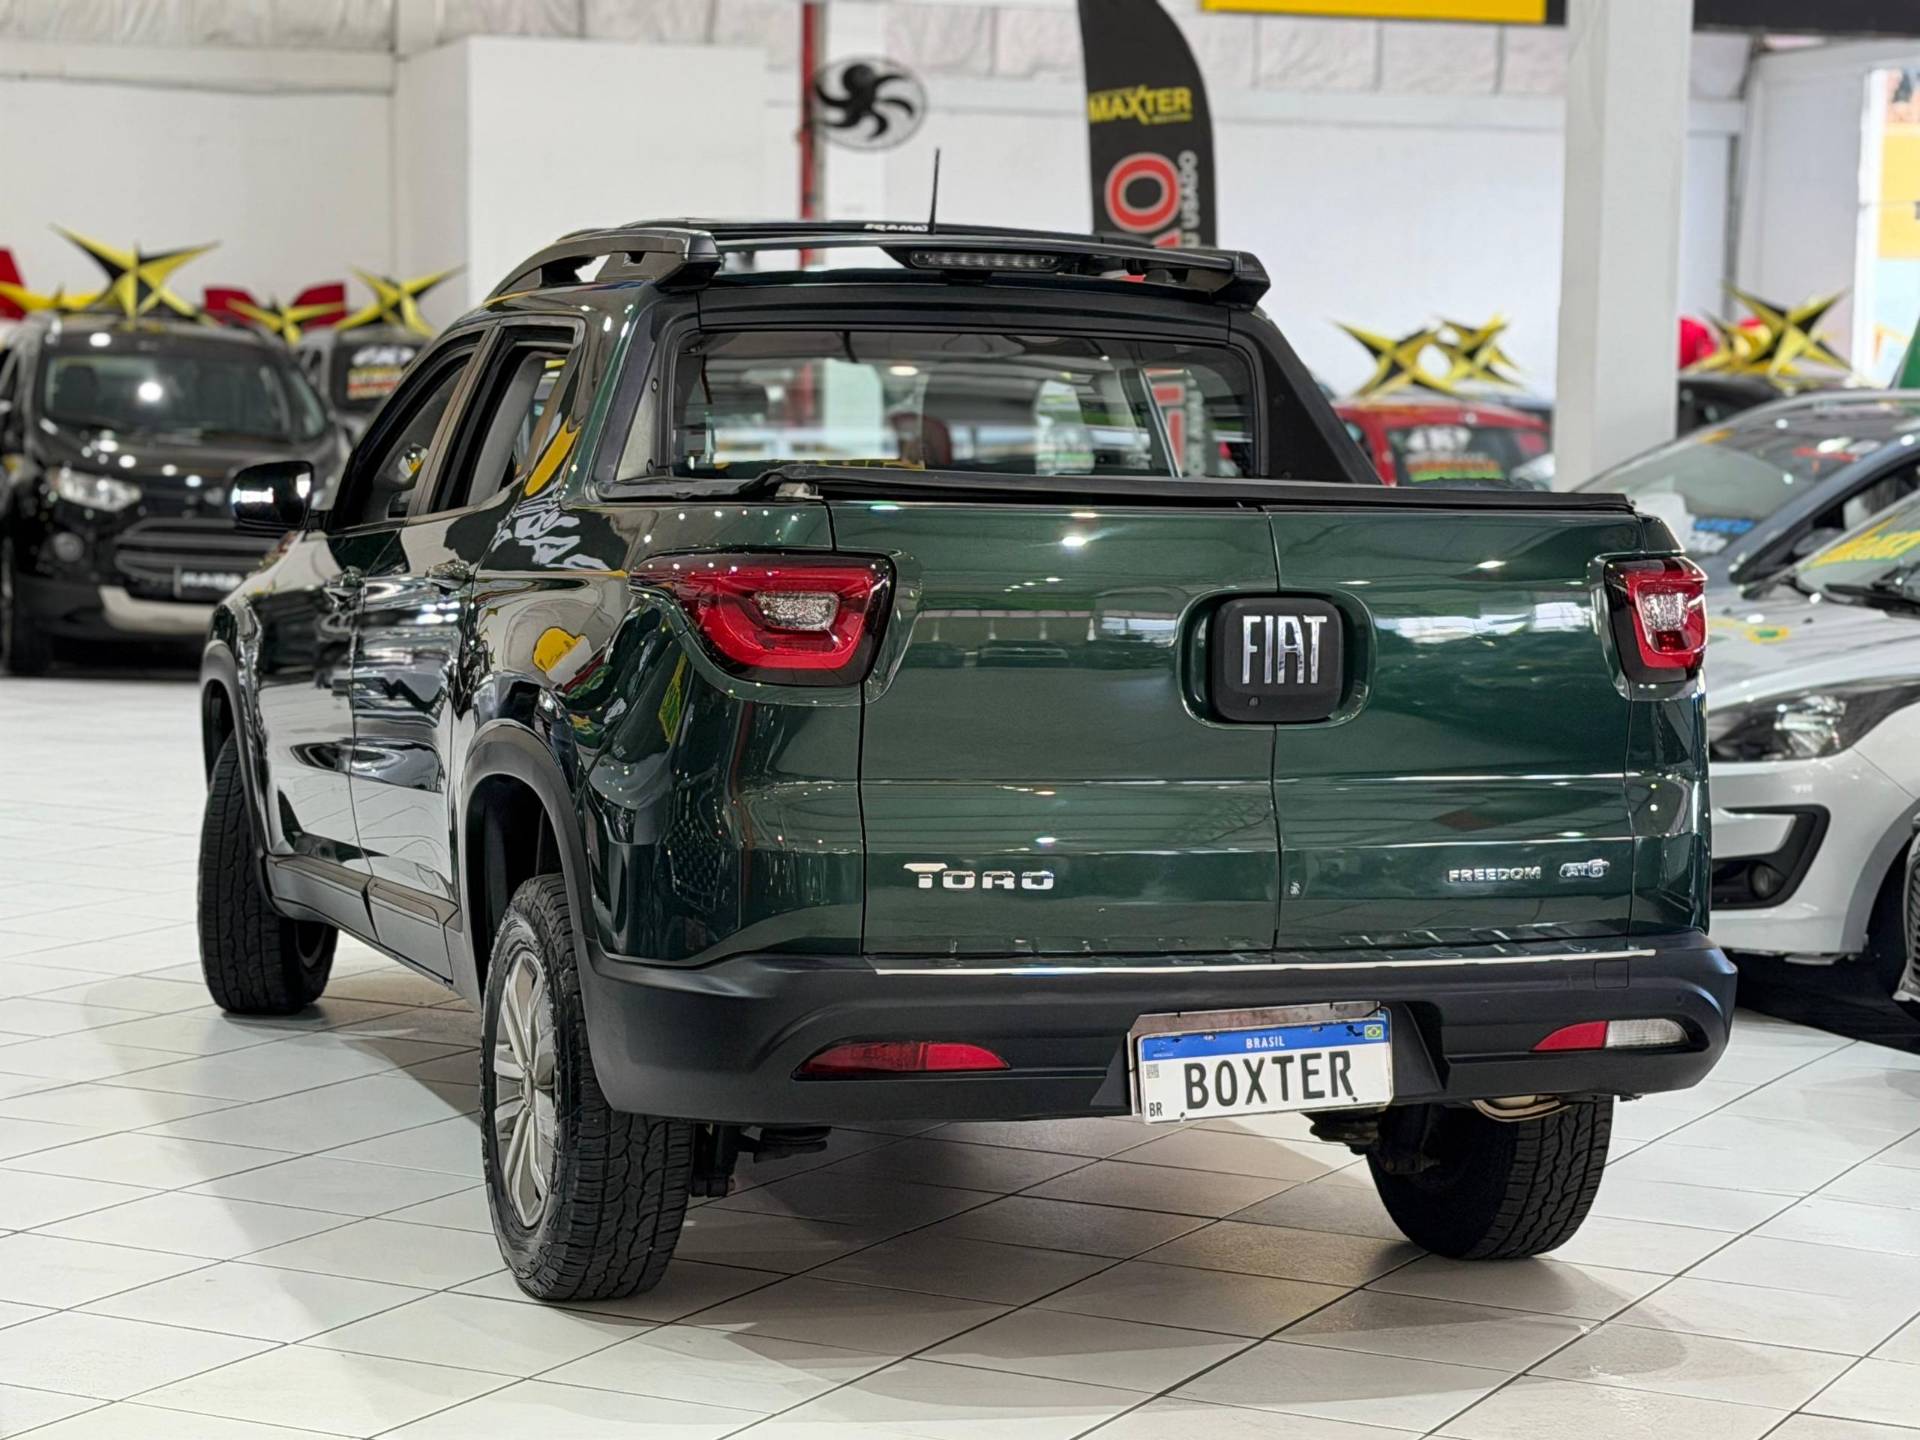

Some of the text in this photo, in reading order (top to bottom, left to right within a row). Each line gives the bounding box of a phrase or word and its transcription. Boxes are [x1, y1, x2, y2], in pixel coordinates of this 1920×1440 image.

[1088, 84, 1192, 125] MAXTER
[1177, 149, 1200, 229] USADO
[1242, 615, 1327, 684] FIAT
[1448, 866, 1542, 882] FREEDOM
[1245, 1035, 1286, 1049] BRASIL
[1184, 1050, 1354, 1110] BOXTER
[1149, 1102, 1163, 1117] BR
